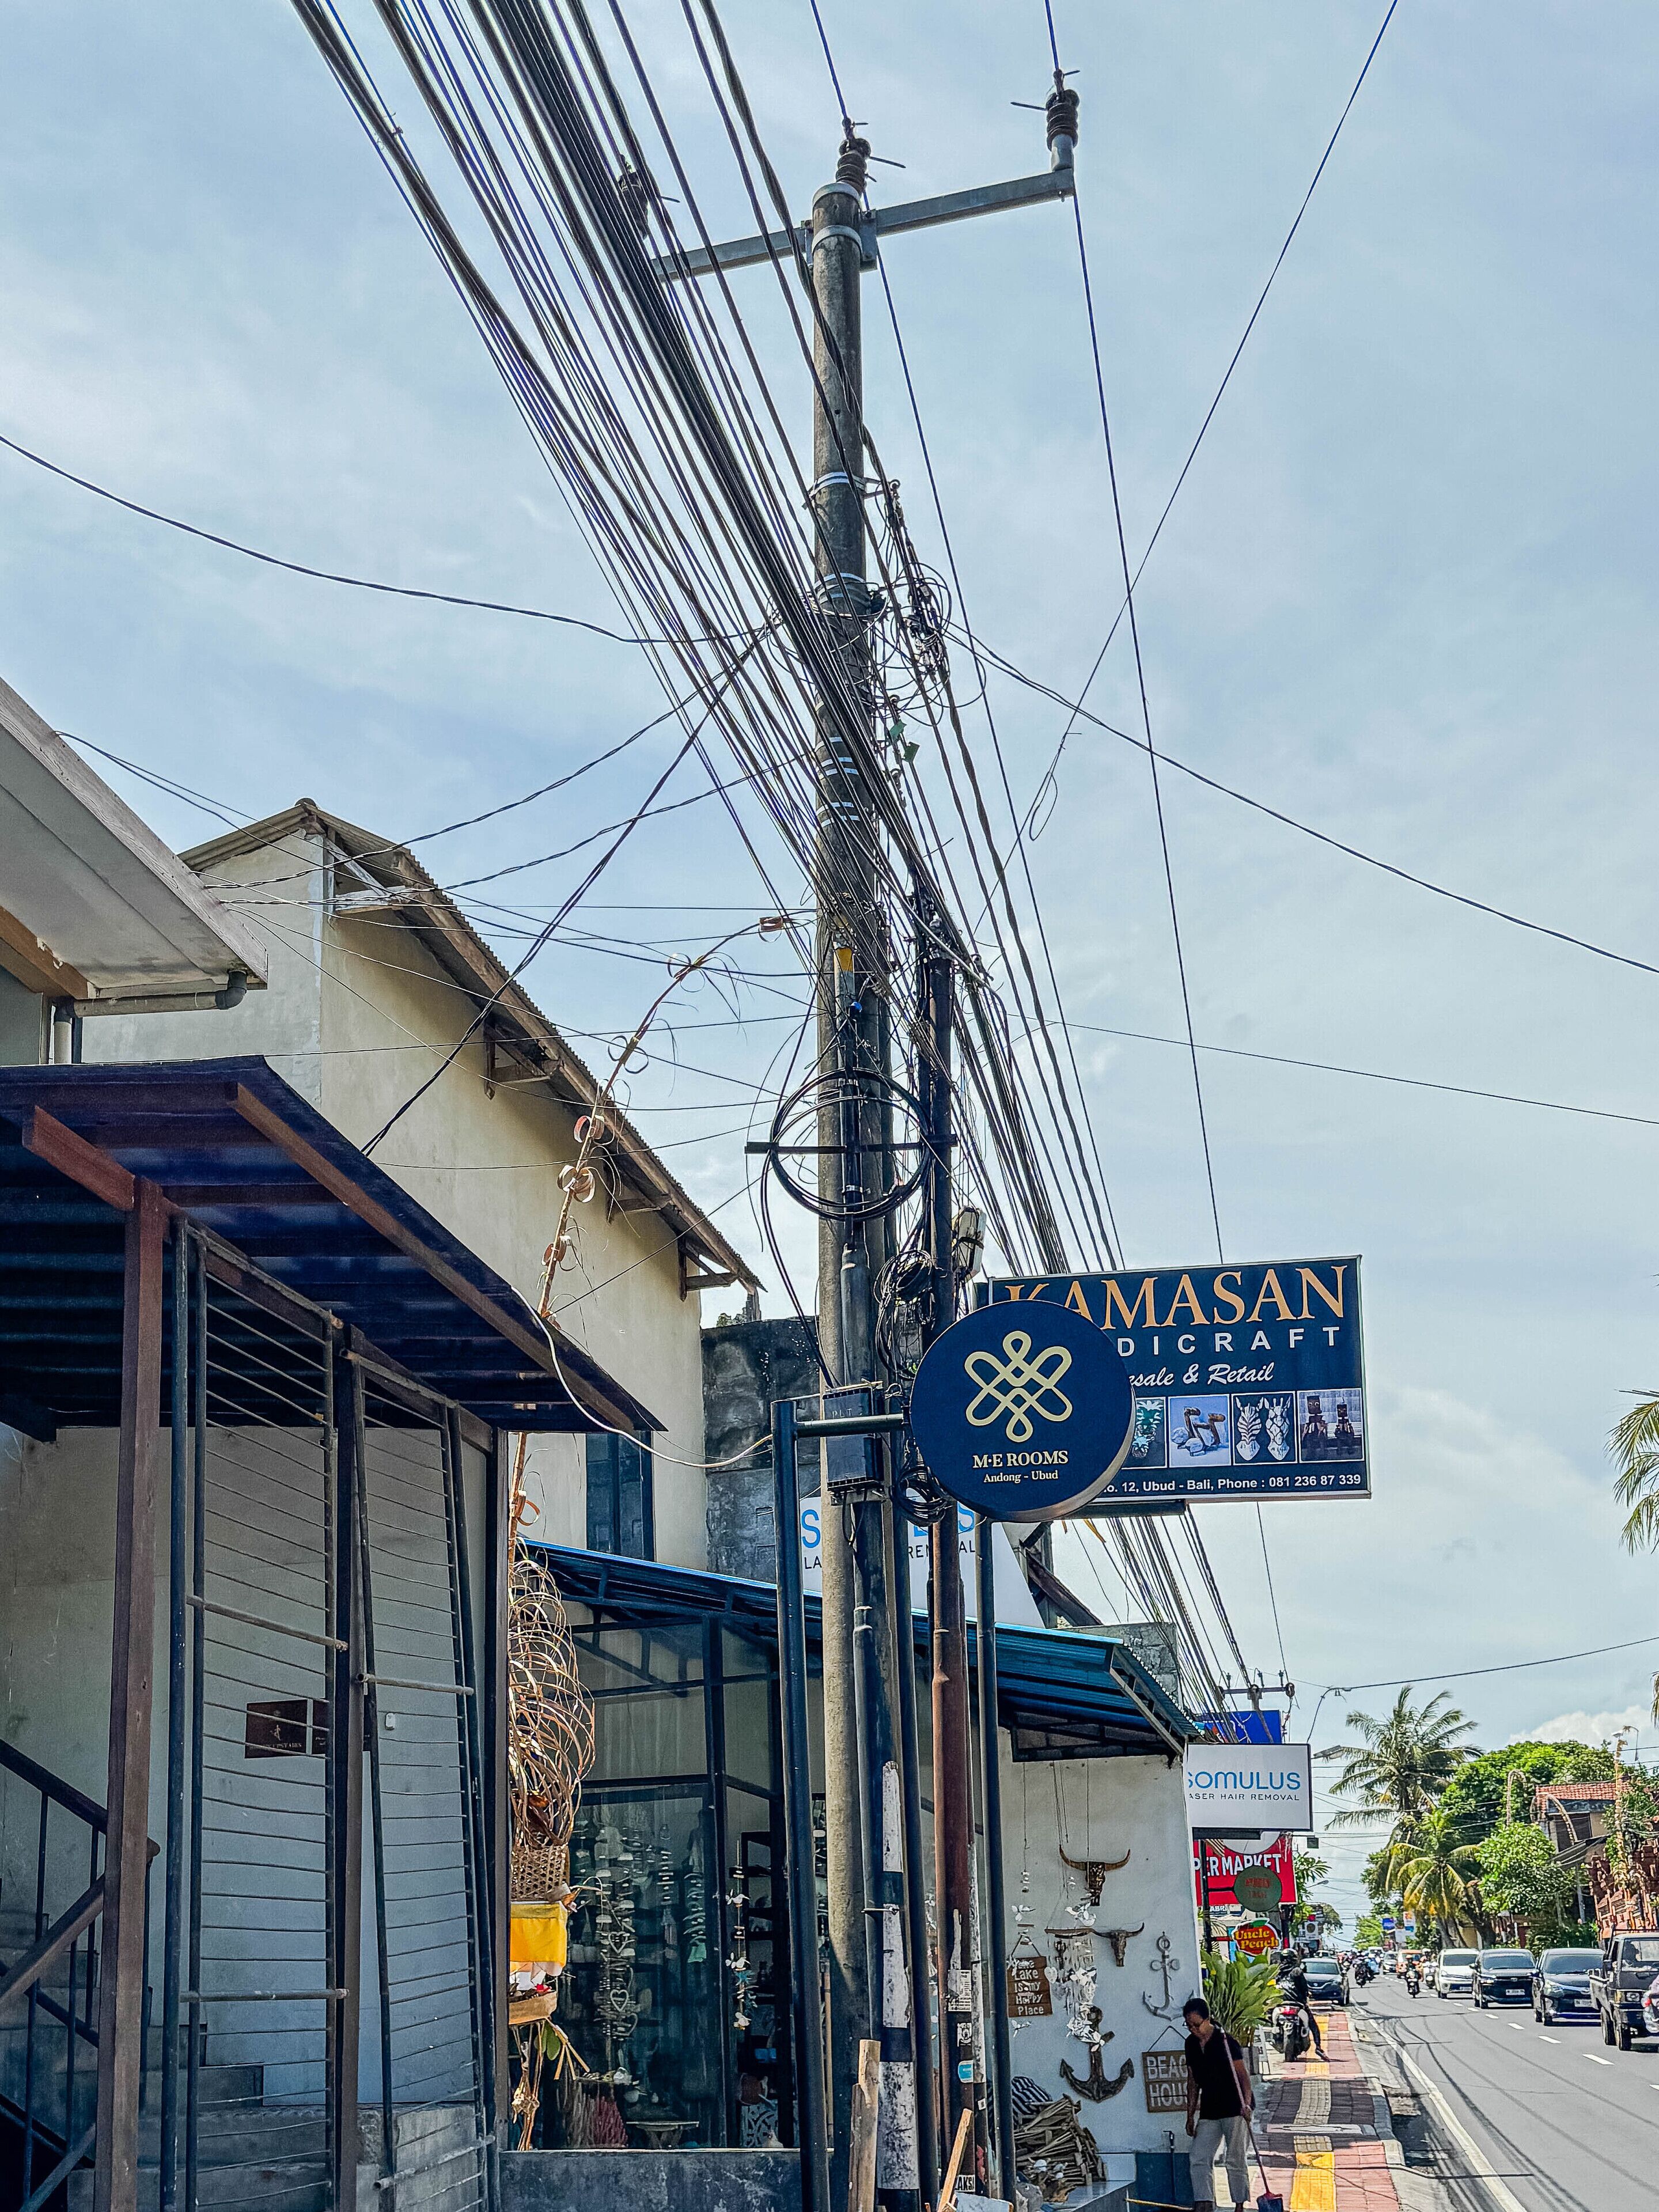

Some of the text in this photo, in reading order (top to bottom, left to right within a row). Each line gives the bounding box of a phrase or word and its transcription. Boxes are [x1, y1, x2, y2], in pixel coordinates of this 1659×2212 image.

[1005, 1265, 1347, 1330] AMASAN
[1183, 1363, 1199, 1384] &
[1207, 1362, 1275, 1384] Retail
[1006, 1450, 1069, 1467] ROOMS
[983, 1472, 1021, 1484] Andong
[1031, 1469, 1059, 1480] Ubud
[1122, 1482, 1139, 1493] 12,
[1143, 1480, 1176, 1491] Ubud
[1187, 1479, 1214, 1491] Bali,
[1218, 1478, 1257, 1488] Phone
[1269, 1476, 1290, 1487] 081
[1294, 1475, 1317, 1486] 236
[1320, 1475, 1335, 1486] 87
[1339, 1474, 1361, 1485] 339
[1234, 1928, 1270, 1941] Uncle
[1240, 1937, 1279, 1949] Peach
[1014, 1969, 1039, 1980] Lake
[1018, 2006, 1044, 2016] Place
